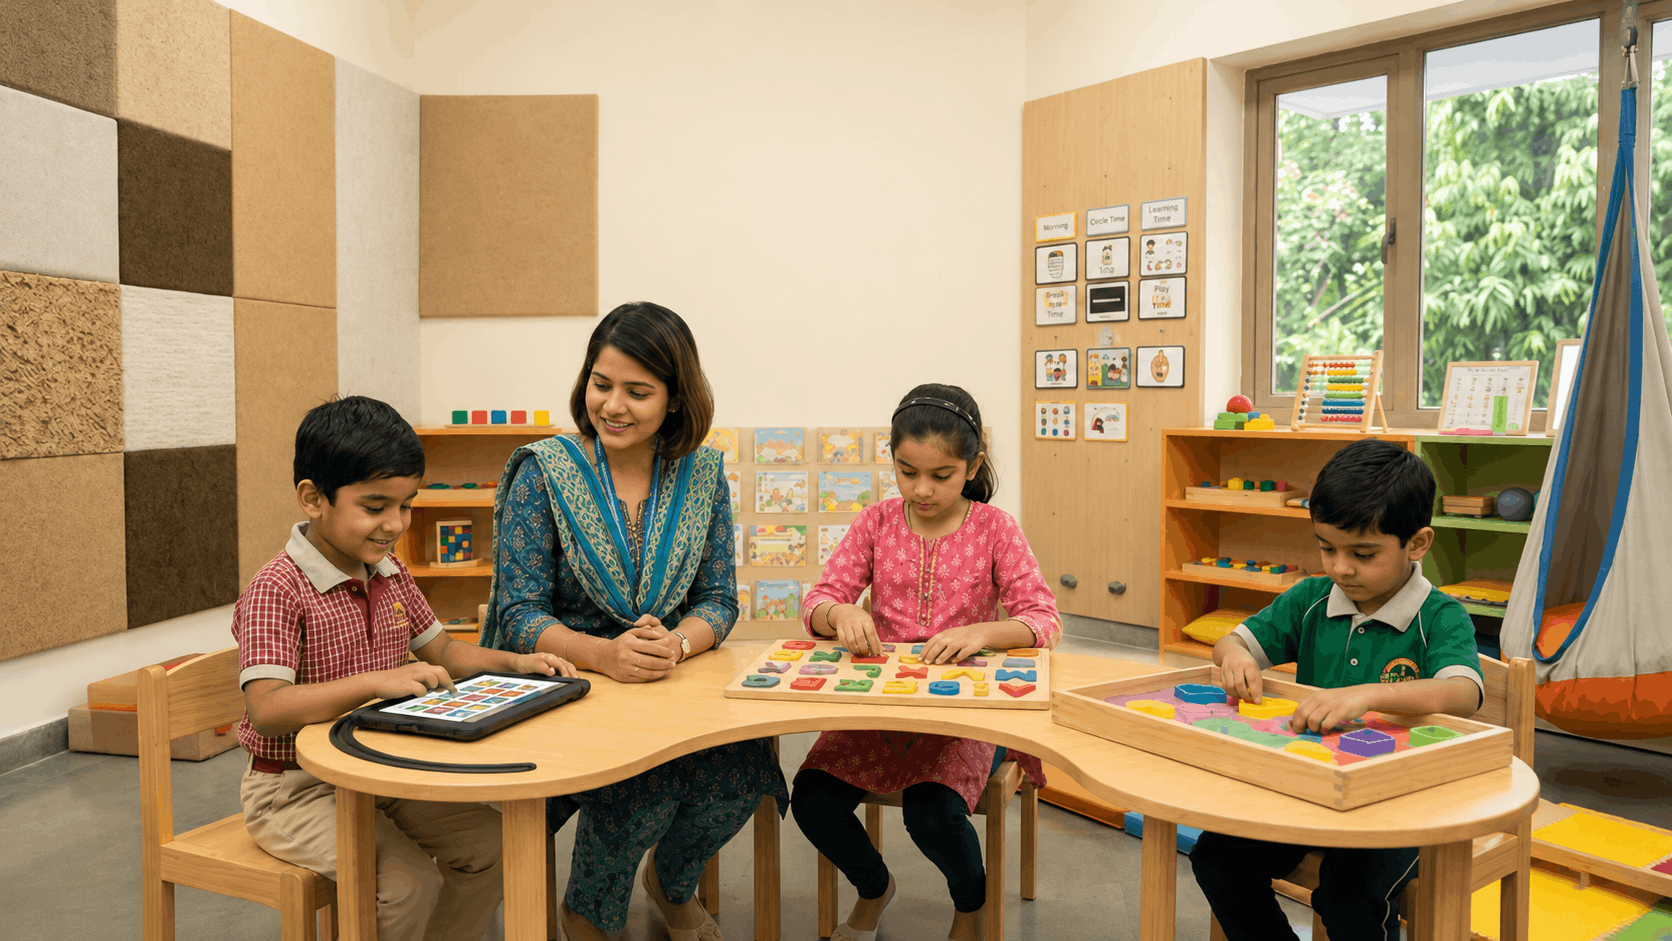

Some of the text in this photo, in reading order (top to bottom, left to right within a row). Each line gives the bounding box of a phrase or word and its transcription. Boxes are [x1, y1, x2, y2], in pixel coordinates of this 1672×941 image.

[1148, 203, 1179, 214] Learning
[1090, 215, 1126, 226] Circle Time
[1153, 215, 1172, 224] Time
[1043, 222, 1069, 231] Morning
[1154, 285, 1170, 294] Play
[1047, 310, 1064, 318] Time
